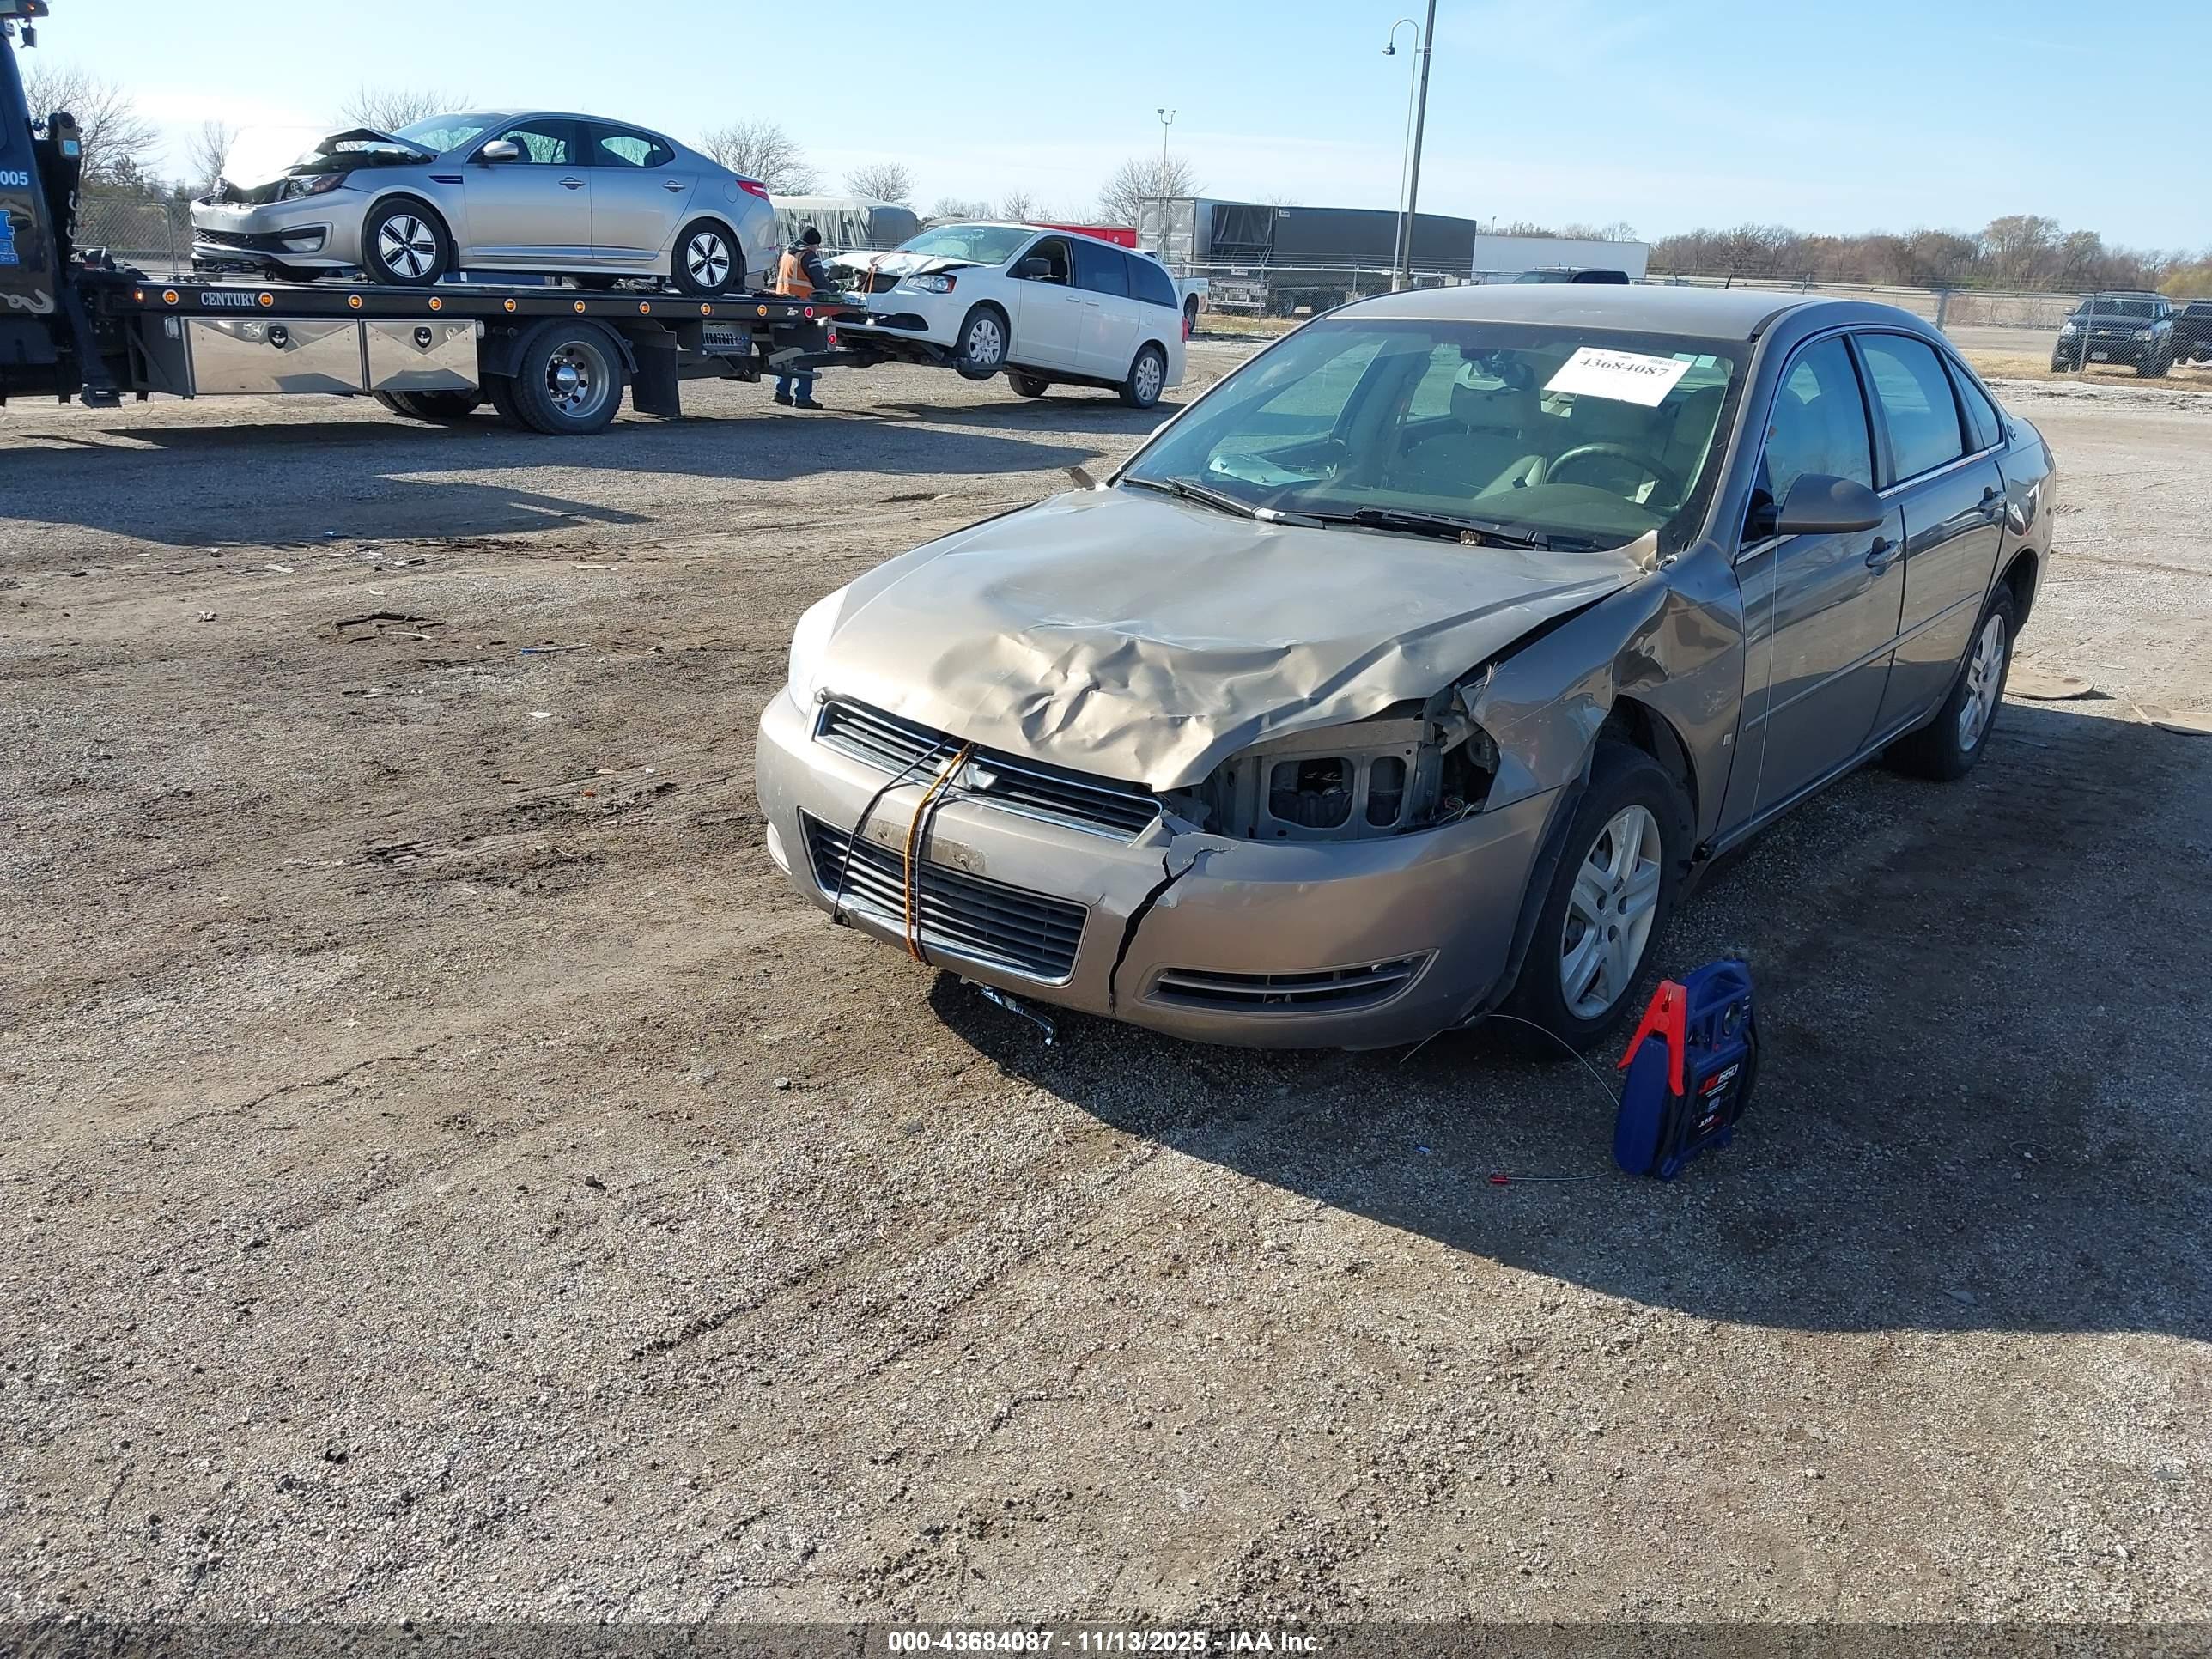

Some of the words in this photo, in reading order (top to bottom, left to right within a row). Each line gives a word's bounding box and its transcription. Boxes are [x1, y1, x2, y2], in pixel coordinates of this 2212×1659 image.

[0, 171, 28, 185] 005
[201, 292, 256, 306] CENTURY
[1579, 357, 1669, 376] 43684087
